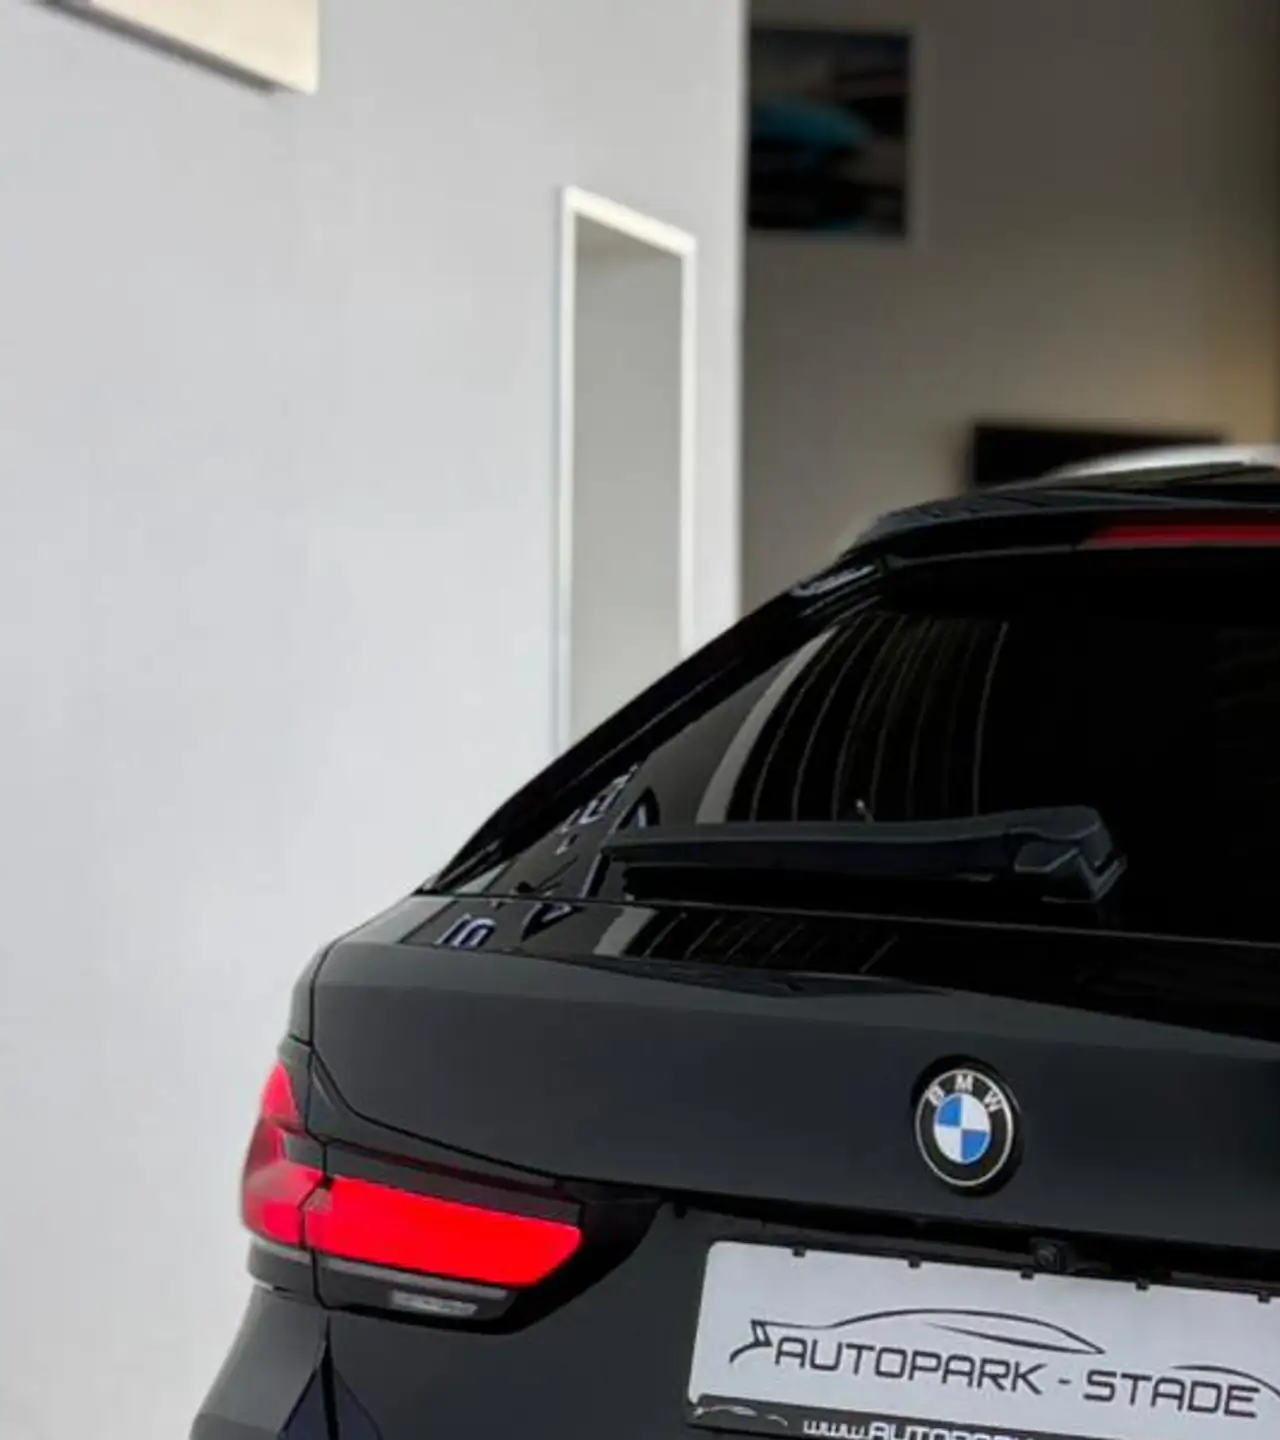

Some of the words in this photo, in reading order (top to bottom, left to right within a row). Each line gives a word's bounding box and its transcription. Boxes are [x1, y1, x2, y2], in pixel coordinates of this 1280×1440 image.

[927, 1074, 1002, 1113] BMW
[775, 1336, 1047, 1395] AUTOPARK
[1083, 1369, 1260, 1418] STADE
